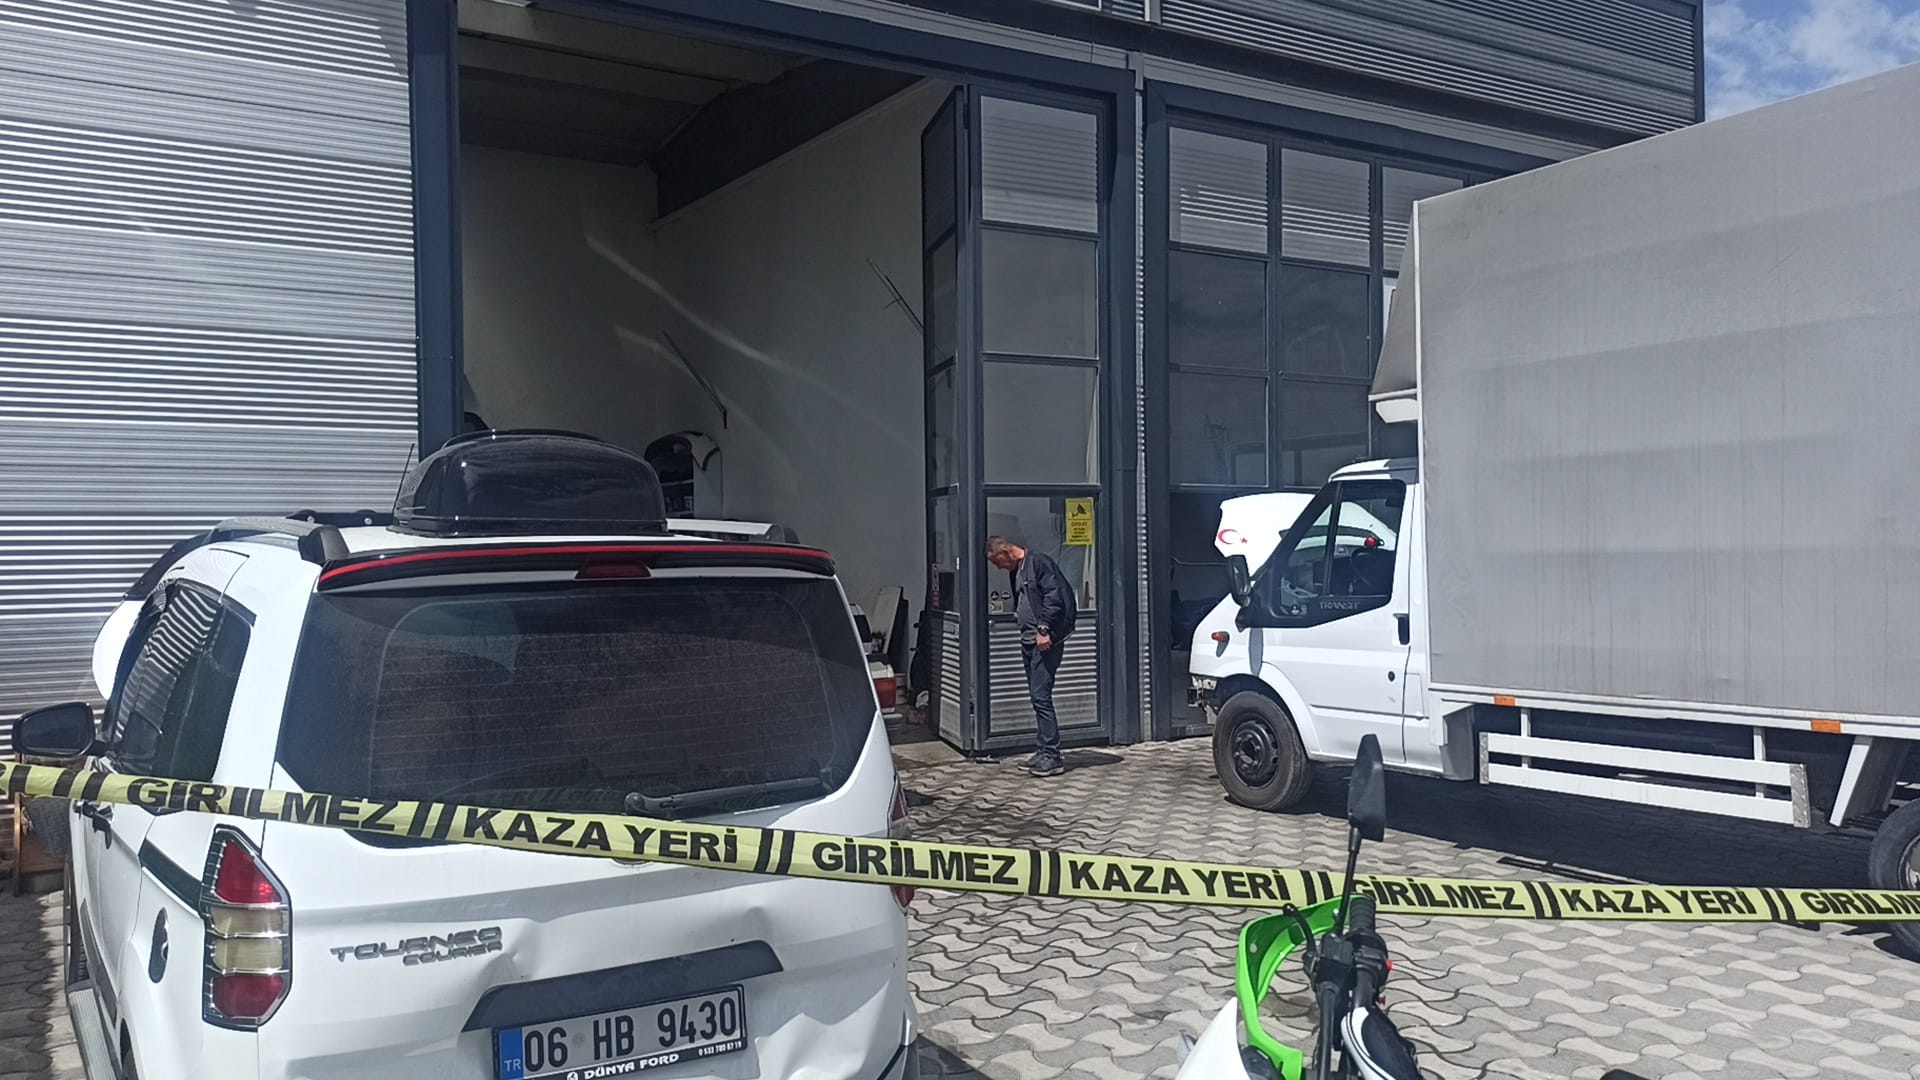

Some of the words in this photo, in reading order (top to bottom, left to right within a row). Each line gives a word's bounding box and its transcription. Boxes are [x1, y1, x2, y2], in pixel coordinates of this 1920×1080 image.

[463, 807, 612, 851] KAZA
[623, 824, 738, 863] YERİ
[812, 837, 1019, 886] GİRİLMEZ
[1068, 860, 1190, 896] KAZA
[1192, 869, 1291, 901] YERİ
[1559, 888, 1671, 914] KAZA
[1664, 886, 1758, 914] YERİ
[330, 926, 503, 963] TOURNEO
[402, 940, 503, 967] COURIER
[524, 1026, 569, 1073] 06
[593, 1014, 635, 1061] HB
[656, 997, 737, 1048] 9430
[503, 1058, 522, 1073] TR
[583, 1062, 635, 1080] DÜNYA
[639, 1053, 680, 1070] FORD
